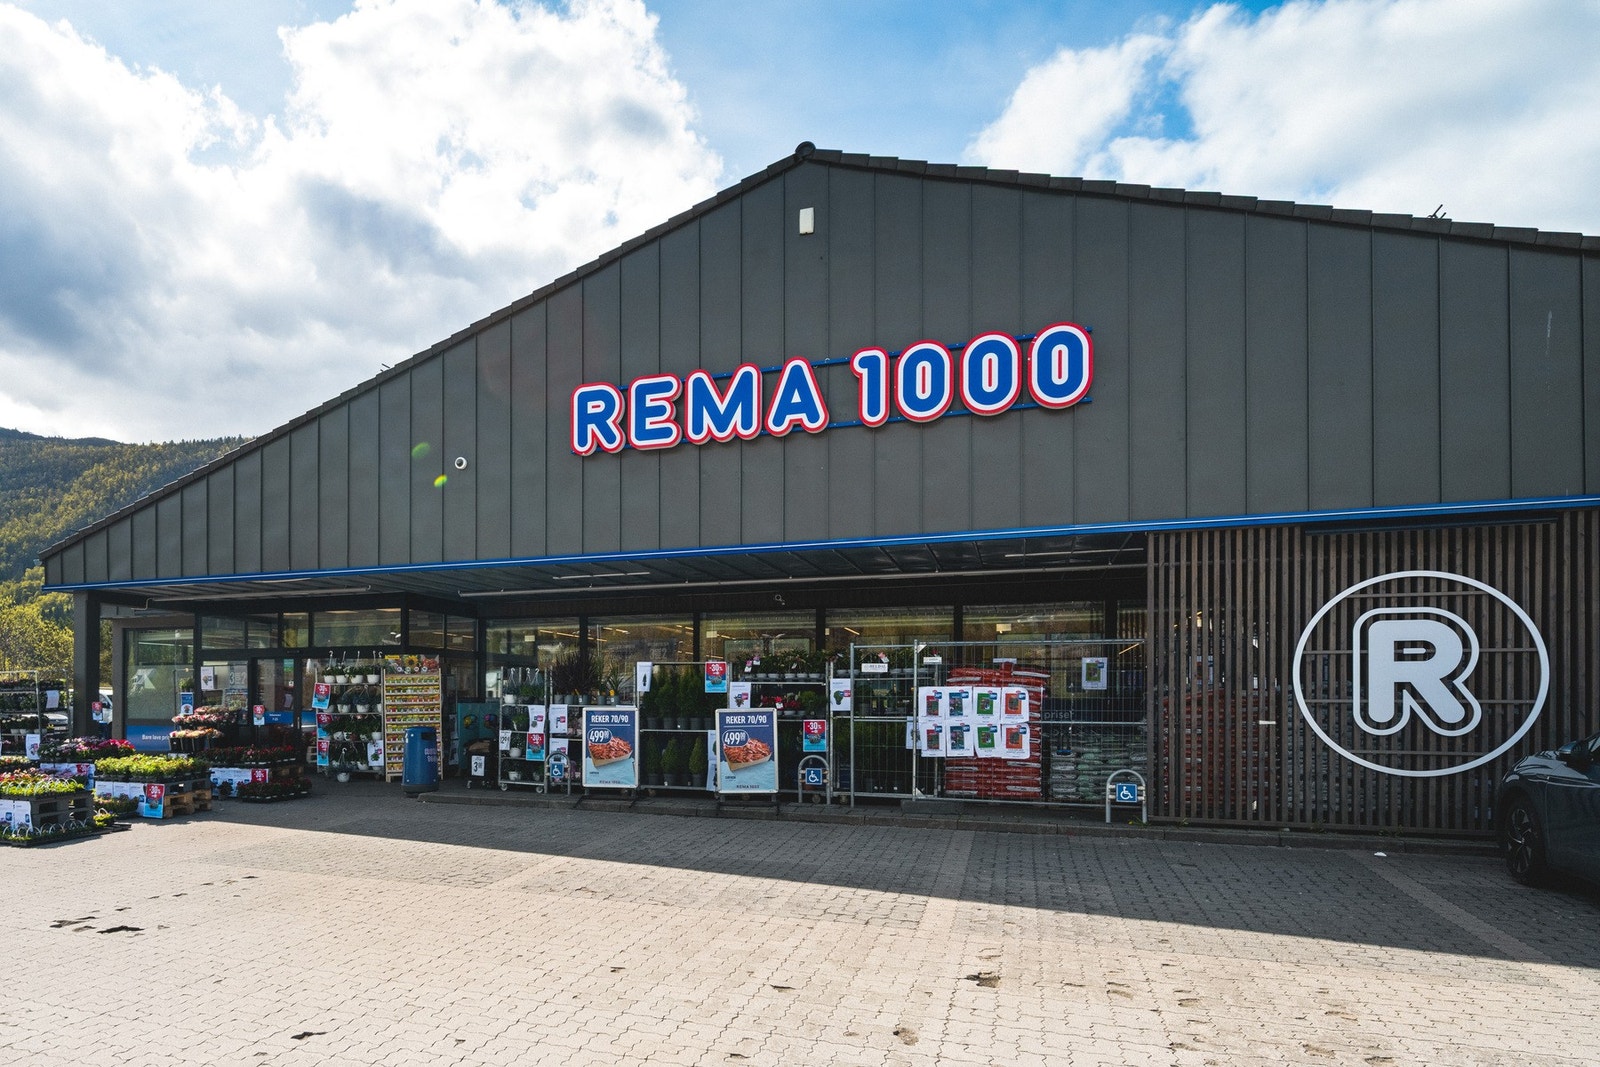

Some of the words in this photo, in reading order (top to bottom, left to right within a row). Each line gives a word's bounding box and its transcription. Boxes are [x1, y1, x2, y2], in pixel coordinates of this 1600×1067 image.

[571, 357, 829, 456] REMA
[851, 322, 1094, 428] 1000
[1352, 606, 1482, 737] R
[591, 714, 609, 723] REKER
[610, 714, 629, 723] 70/90
[725, 715, 746, 724] REKER
[747, 714, 767, 724] 70/90
[1044, 710, 1074, 720] priser
[589, 730, 604, 743] 499
[724, 731, 740, 745] 499
